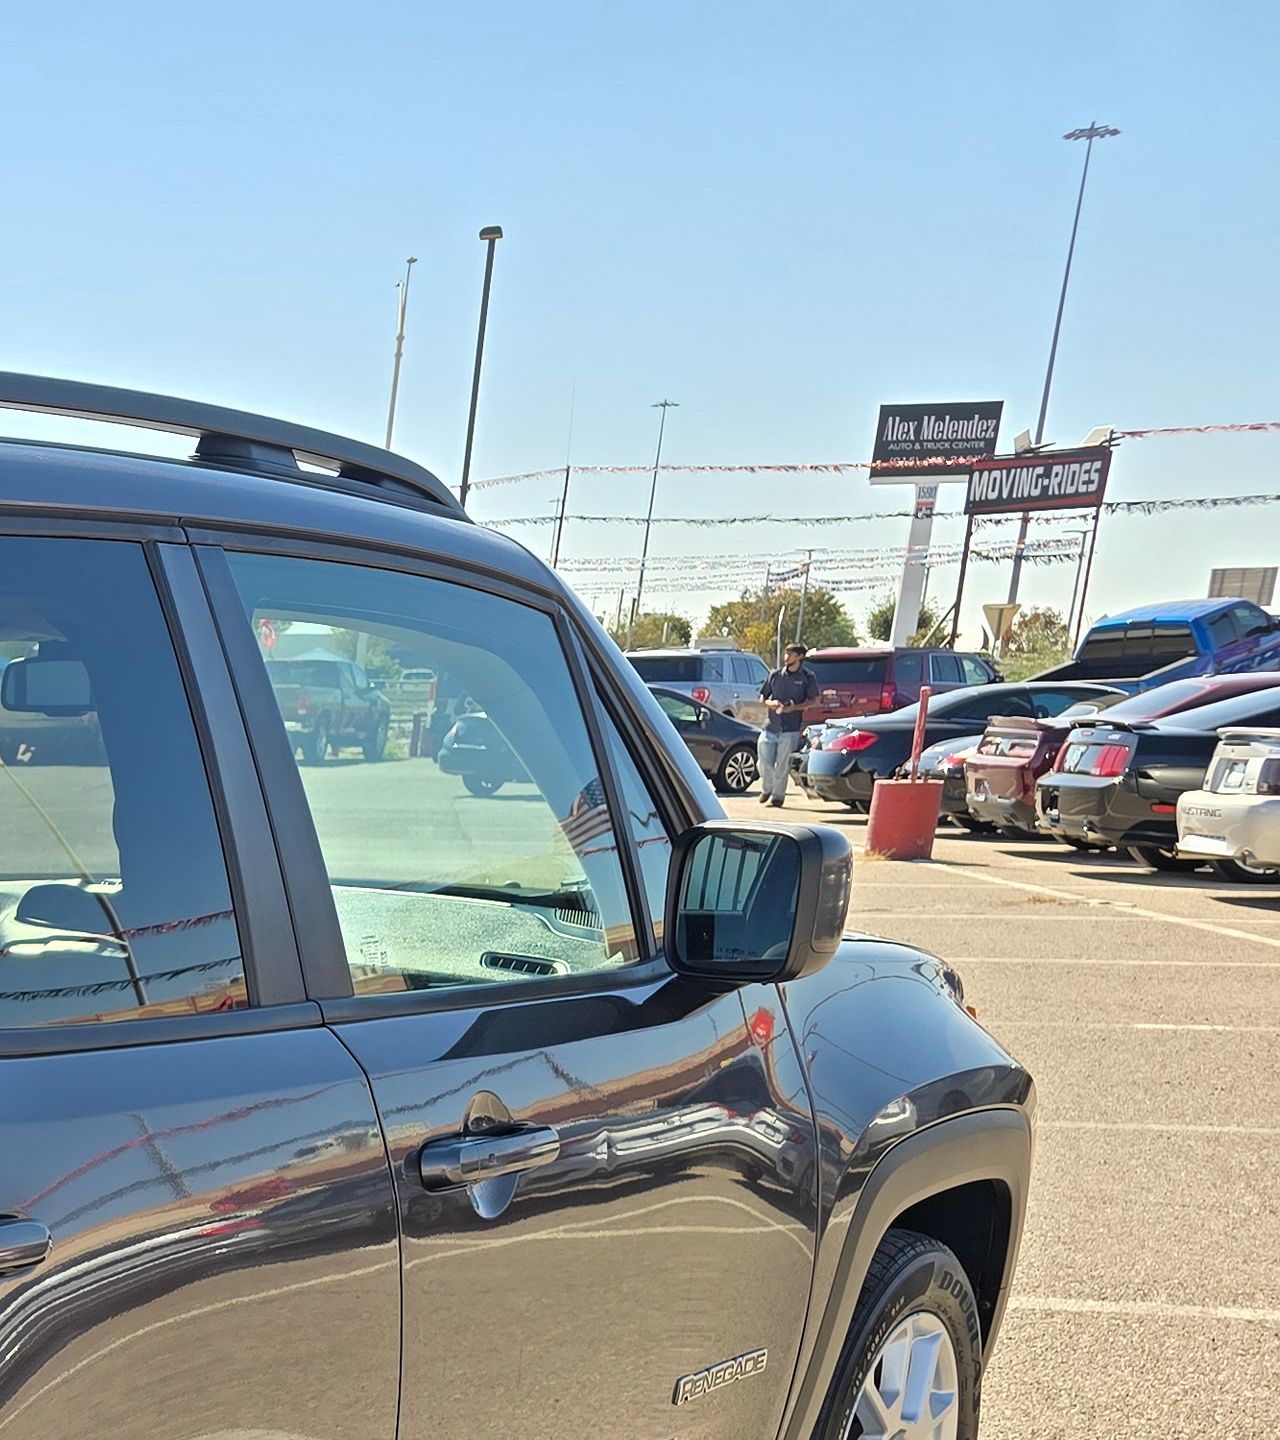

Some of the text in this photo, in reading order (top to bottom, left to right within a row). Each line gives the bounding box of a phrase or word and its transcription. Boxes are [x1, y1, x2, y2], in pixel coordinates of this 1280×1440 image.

[882, 414, 997, 441] Alex Melendez
[923, 441, 950, 449] TRUCK
[952, 440, 985, 449] CENTER
[970, 461, 1102, 501] MOVING-RIDES
[677, 1348, 768, 1406] RENEGADE
